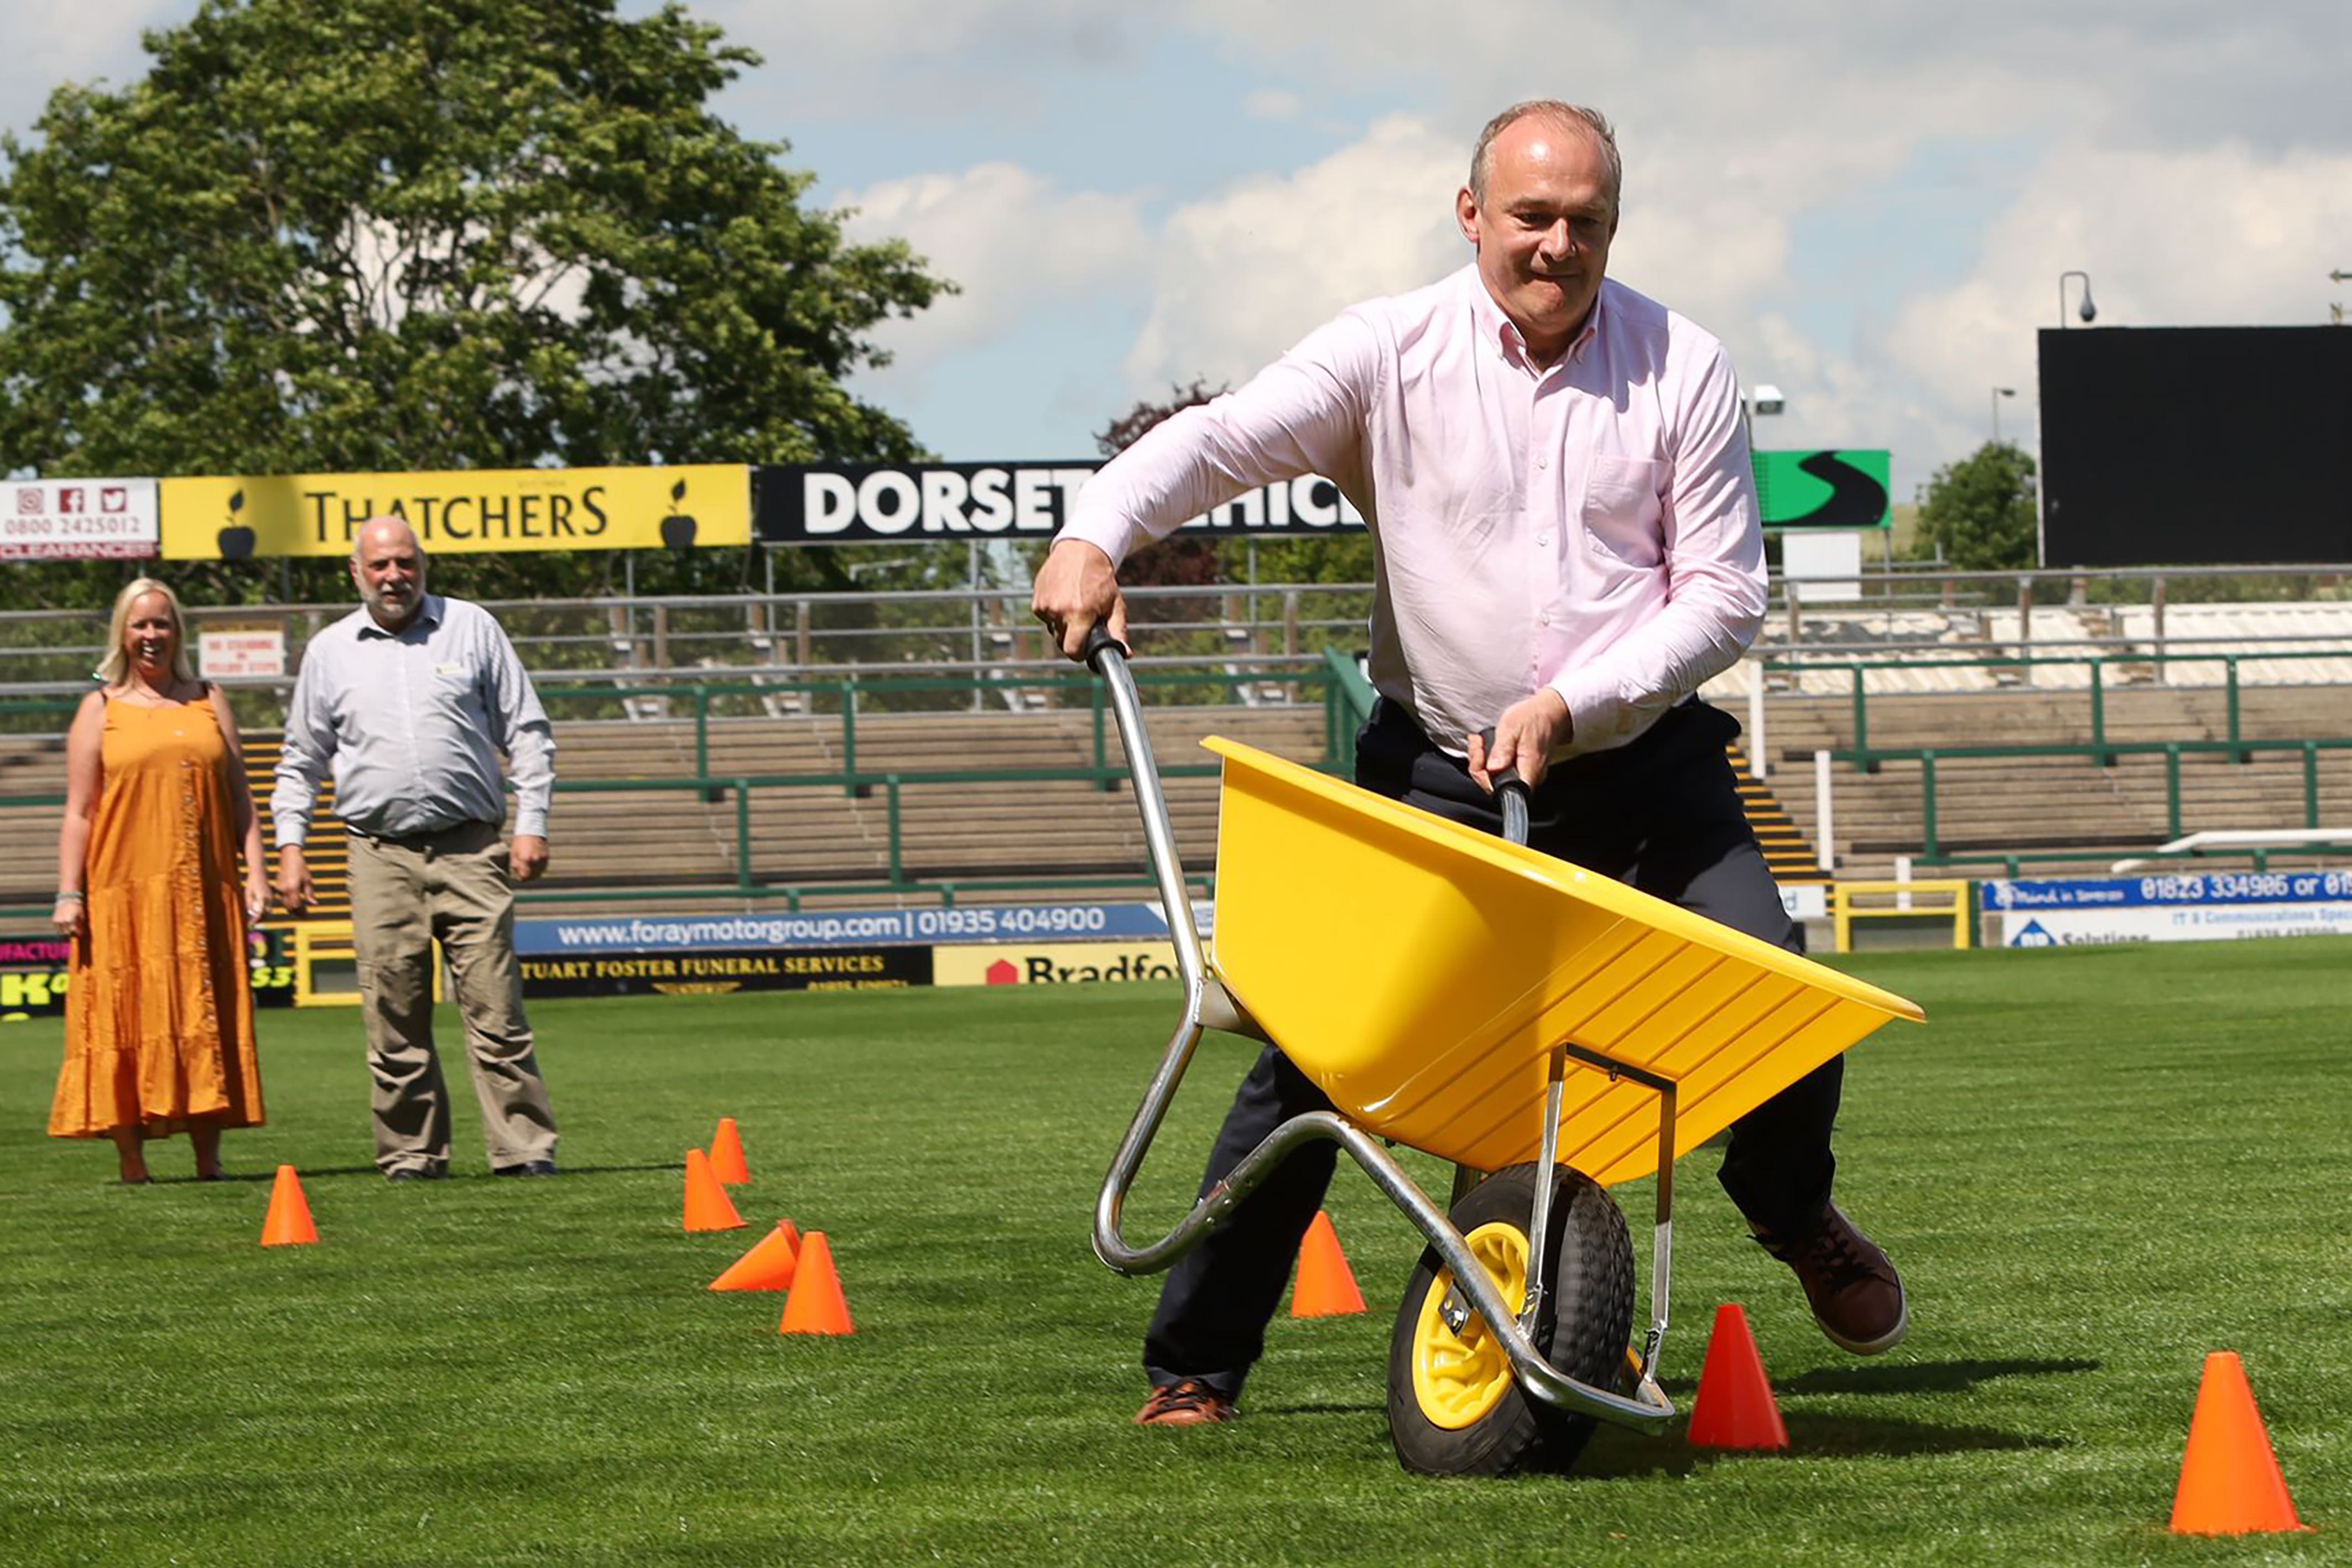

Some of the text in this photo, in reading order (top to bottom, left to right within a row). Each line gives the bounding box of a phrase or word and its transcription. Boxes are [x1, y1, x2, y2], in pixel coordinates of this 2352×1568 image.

[804, 468, 1093, 534] DORSET
[6, 517, 140, 535] 0800 2425012
[2295, 877, 2319, 895] or
[558, 908, 1105, 945] www.foraymotorgroup.com 01935 404900
[520, 955, 884, 979] TUART FOSTER FUNERAL SERVICES
[1025, 955, 1173, 983] Bradfo
